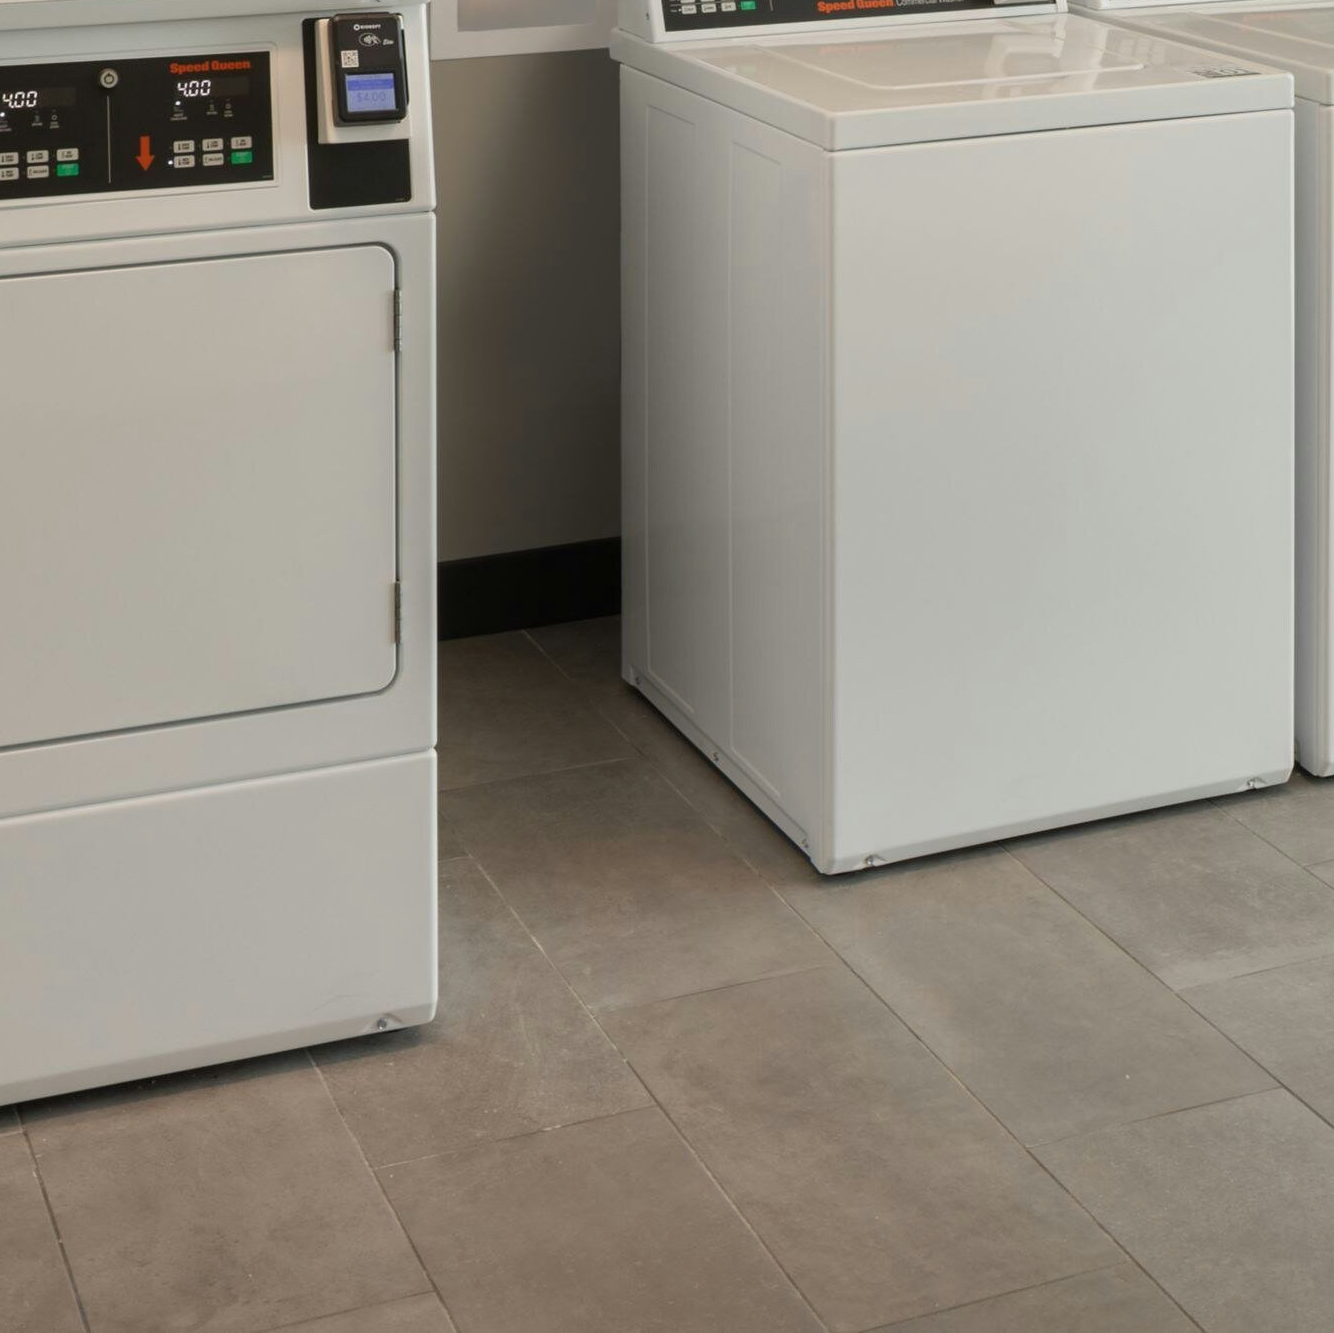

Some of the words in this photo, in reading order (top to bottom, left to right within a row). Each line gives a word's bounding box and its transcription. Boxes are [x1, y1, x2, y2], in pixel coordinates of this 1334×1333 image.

[170, 60, 210, 74] Speed
[211, 59, 251, 70] Queen
[177, 79, 211, 97] 4.00
[2, 90, 38, 109] 4.00
